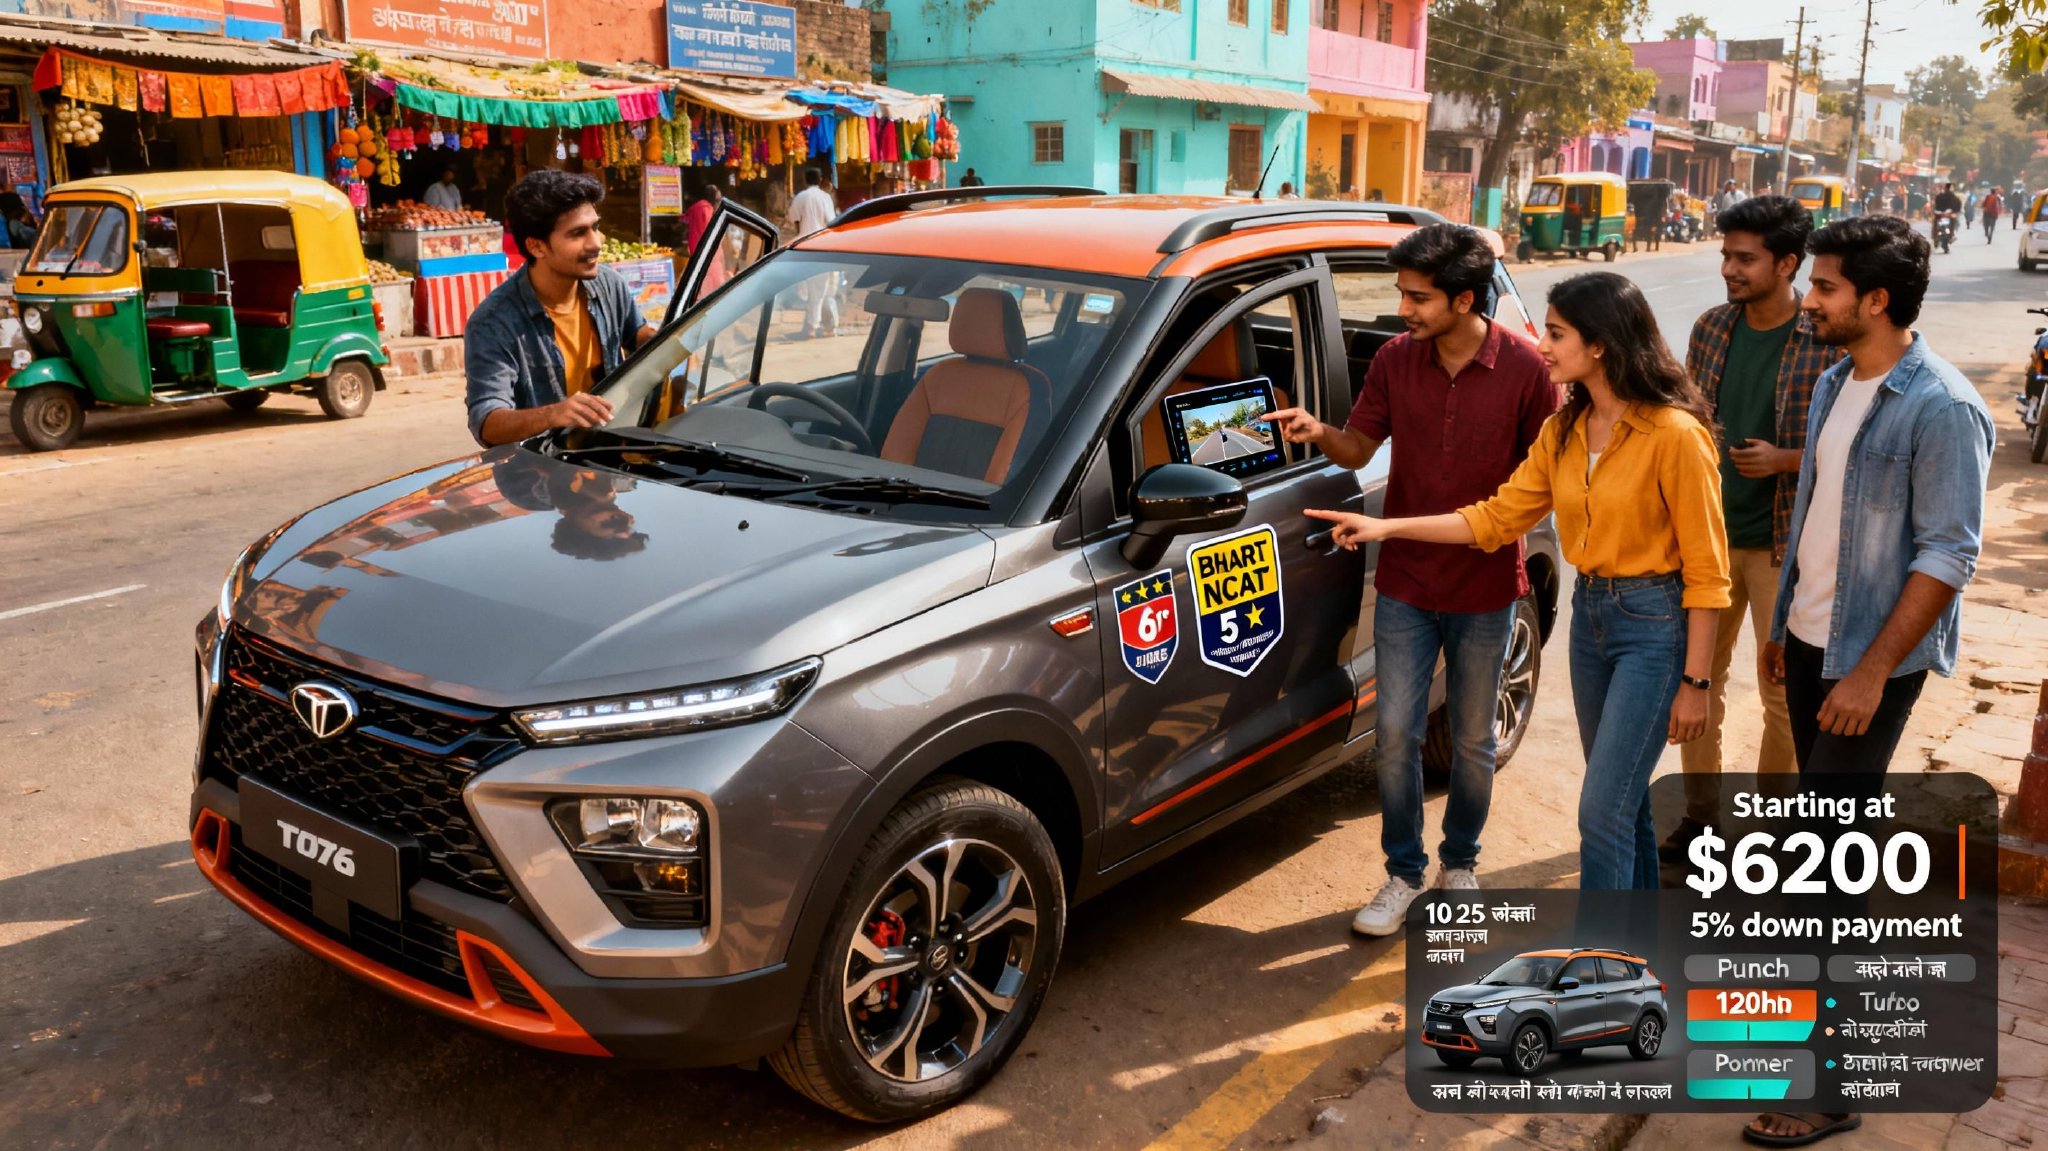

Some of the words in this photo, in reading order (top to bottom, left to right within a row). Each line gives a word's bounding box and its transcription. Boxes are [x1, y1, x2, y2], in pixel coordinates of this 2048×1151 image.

[1197, 539, 1268, 579] BHART
[1203, 567, 1271, 608] NCAT
[1219, 610, 1239, 644] 5
